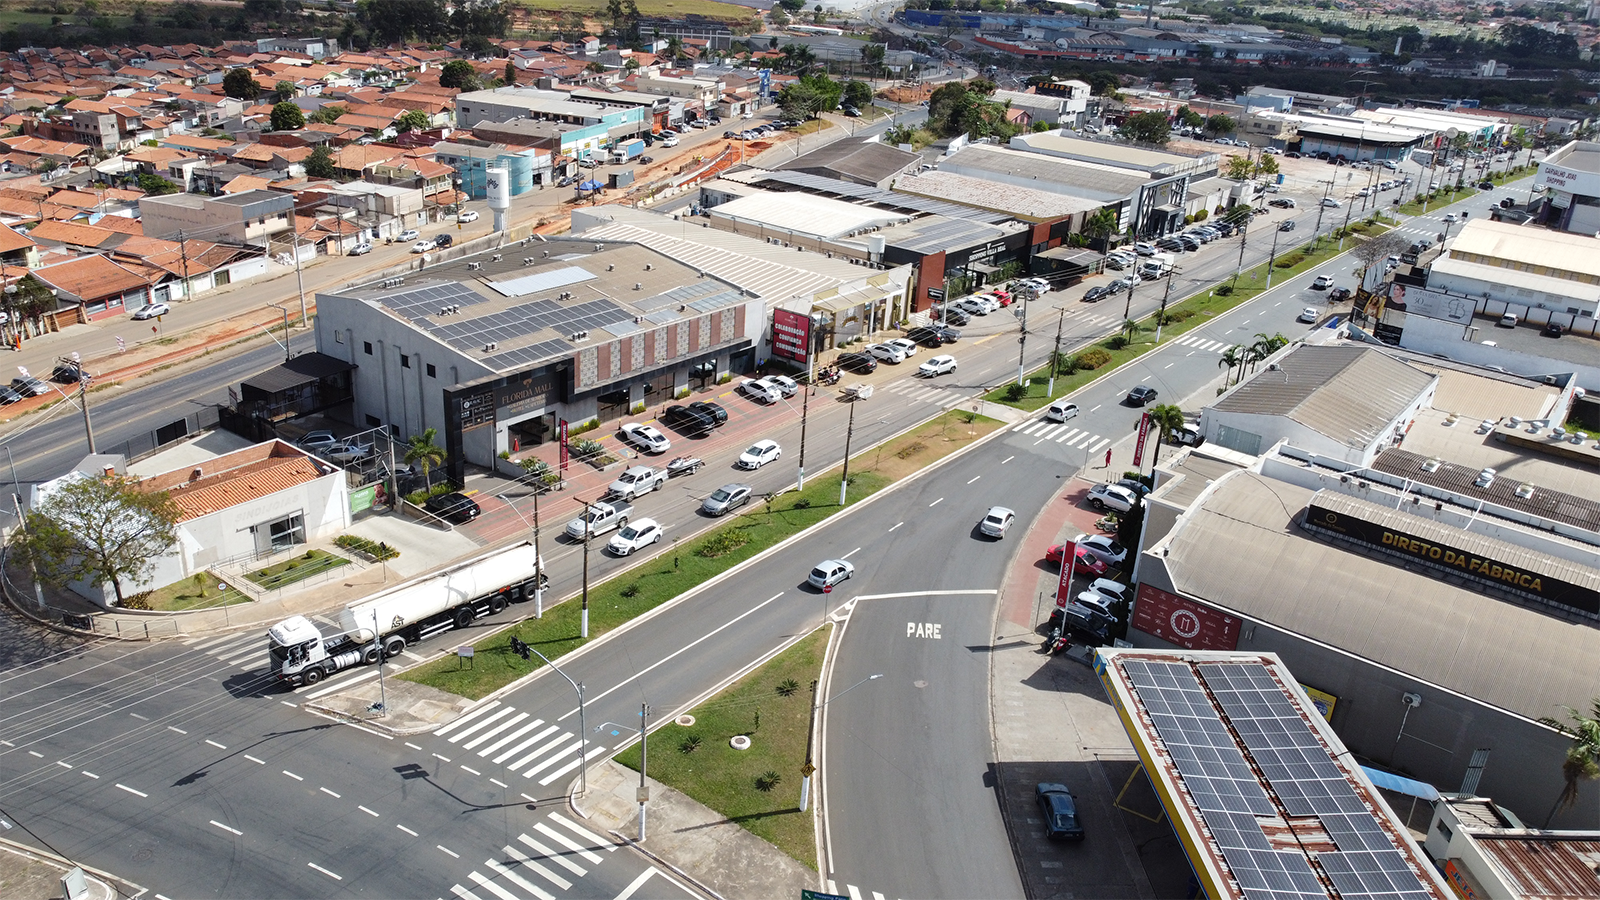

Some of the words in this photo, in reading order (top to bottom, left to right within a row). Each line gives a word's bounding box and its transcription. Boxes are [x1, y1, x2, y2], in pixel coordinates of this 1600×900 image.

[1545, 167, 1566, 178] CARVALHO
[1546, 176, 1566, 187] SHOPPING
[775, 323, 805, 337] COLABORAÇÃO
[779, 333, 802, 345] CONFIANÇA
[776, 342, 806, 356] COMUNICAÇÃO
[502, 390, 534, 405] FLORIDA
[534, 383, 554, 395] MALL
[235, 494, 299, 523] SINDIJOIAS
[1382, 531, 1442, 560] DIRETO
[1444, 550, 1466, 569] DA
[1469, 559, 1542, 592] FÁBRICA
[1062, 563, 1070, 587] ATACADO
[391, 618, 405, 629] AST
[906, 622, 942, 639] PARE
